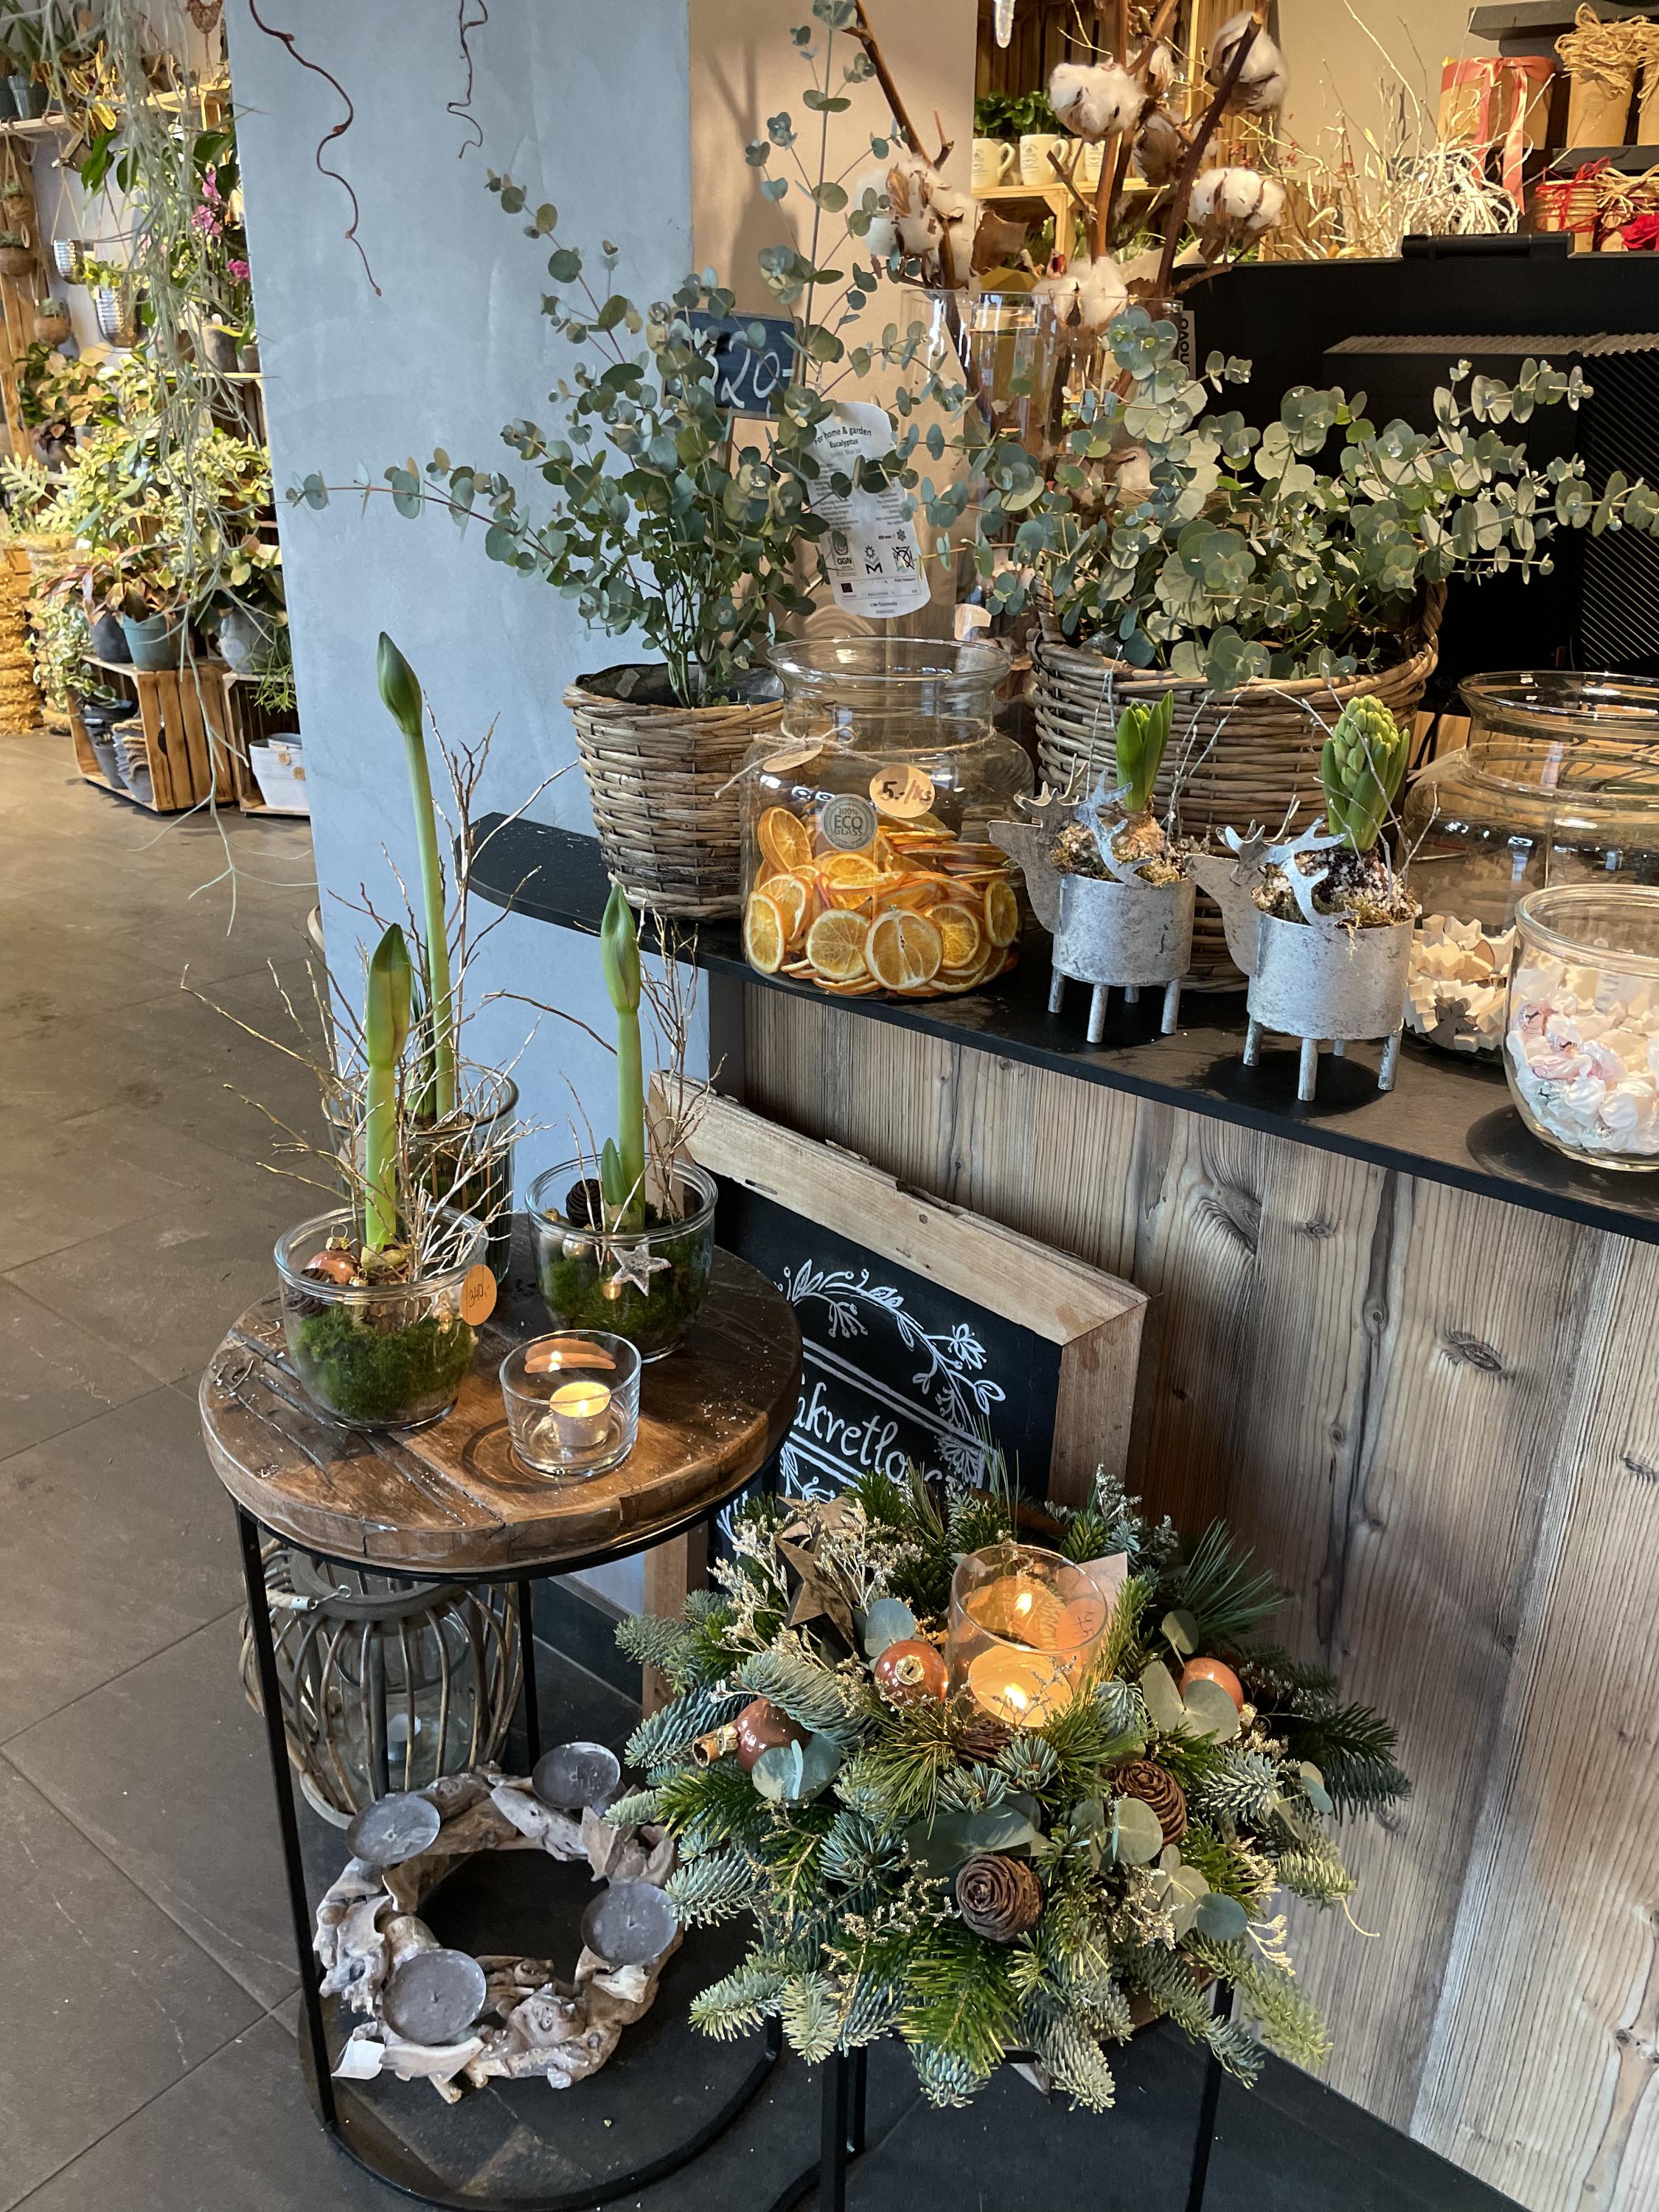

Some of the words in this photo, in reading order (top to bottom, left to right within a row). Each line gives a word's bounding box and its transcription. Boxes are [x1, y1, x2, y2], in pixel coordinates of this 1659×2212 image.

[1180, 318, 1190, 372] novo
[824, 428, 841, 439] home
[843, 426, 848, 434] &
[849, 426, 872, 437] garden
[829, 439, 859, 448] Eucalyptus
[837, 557, 852, 565] GGN
[838, 807, 859, 815] 100%
[834, 815, 863, 830] ECO
[834, 827, 863, 836] GLASS
